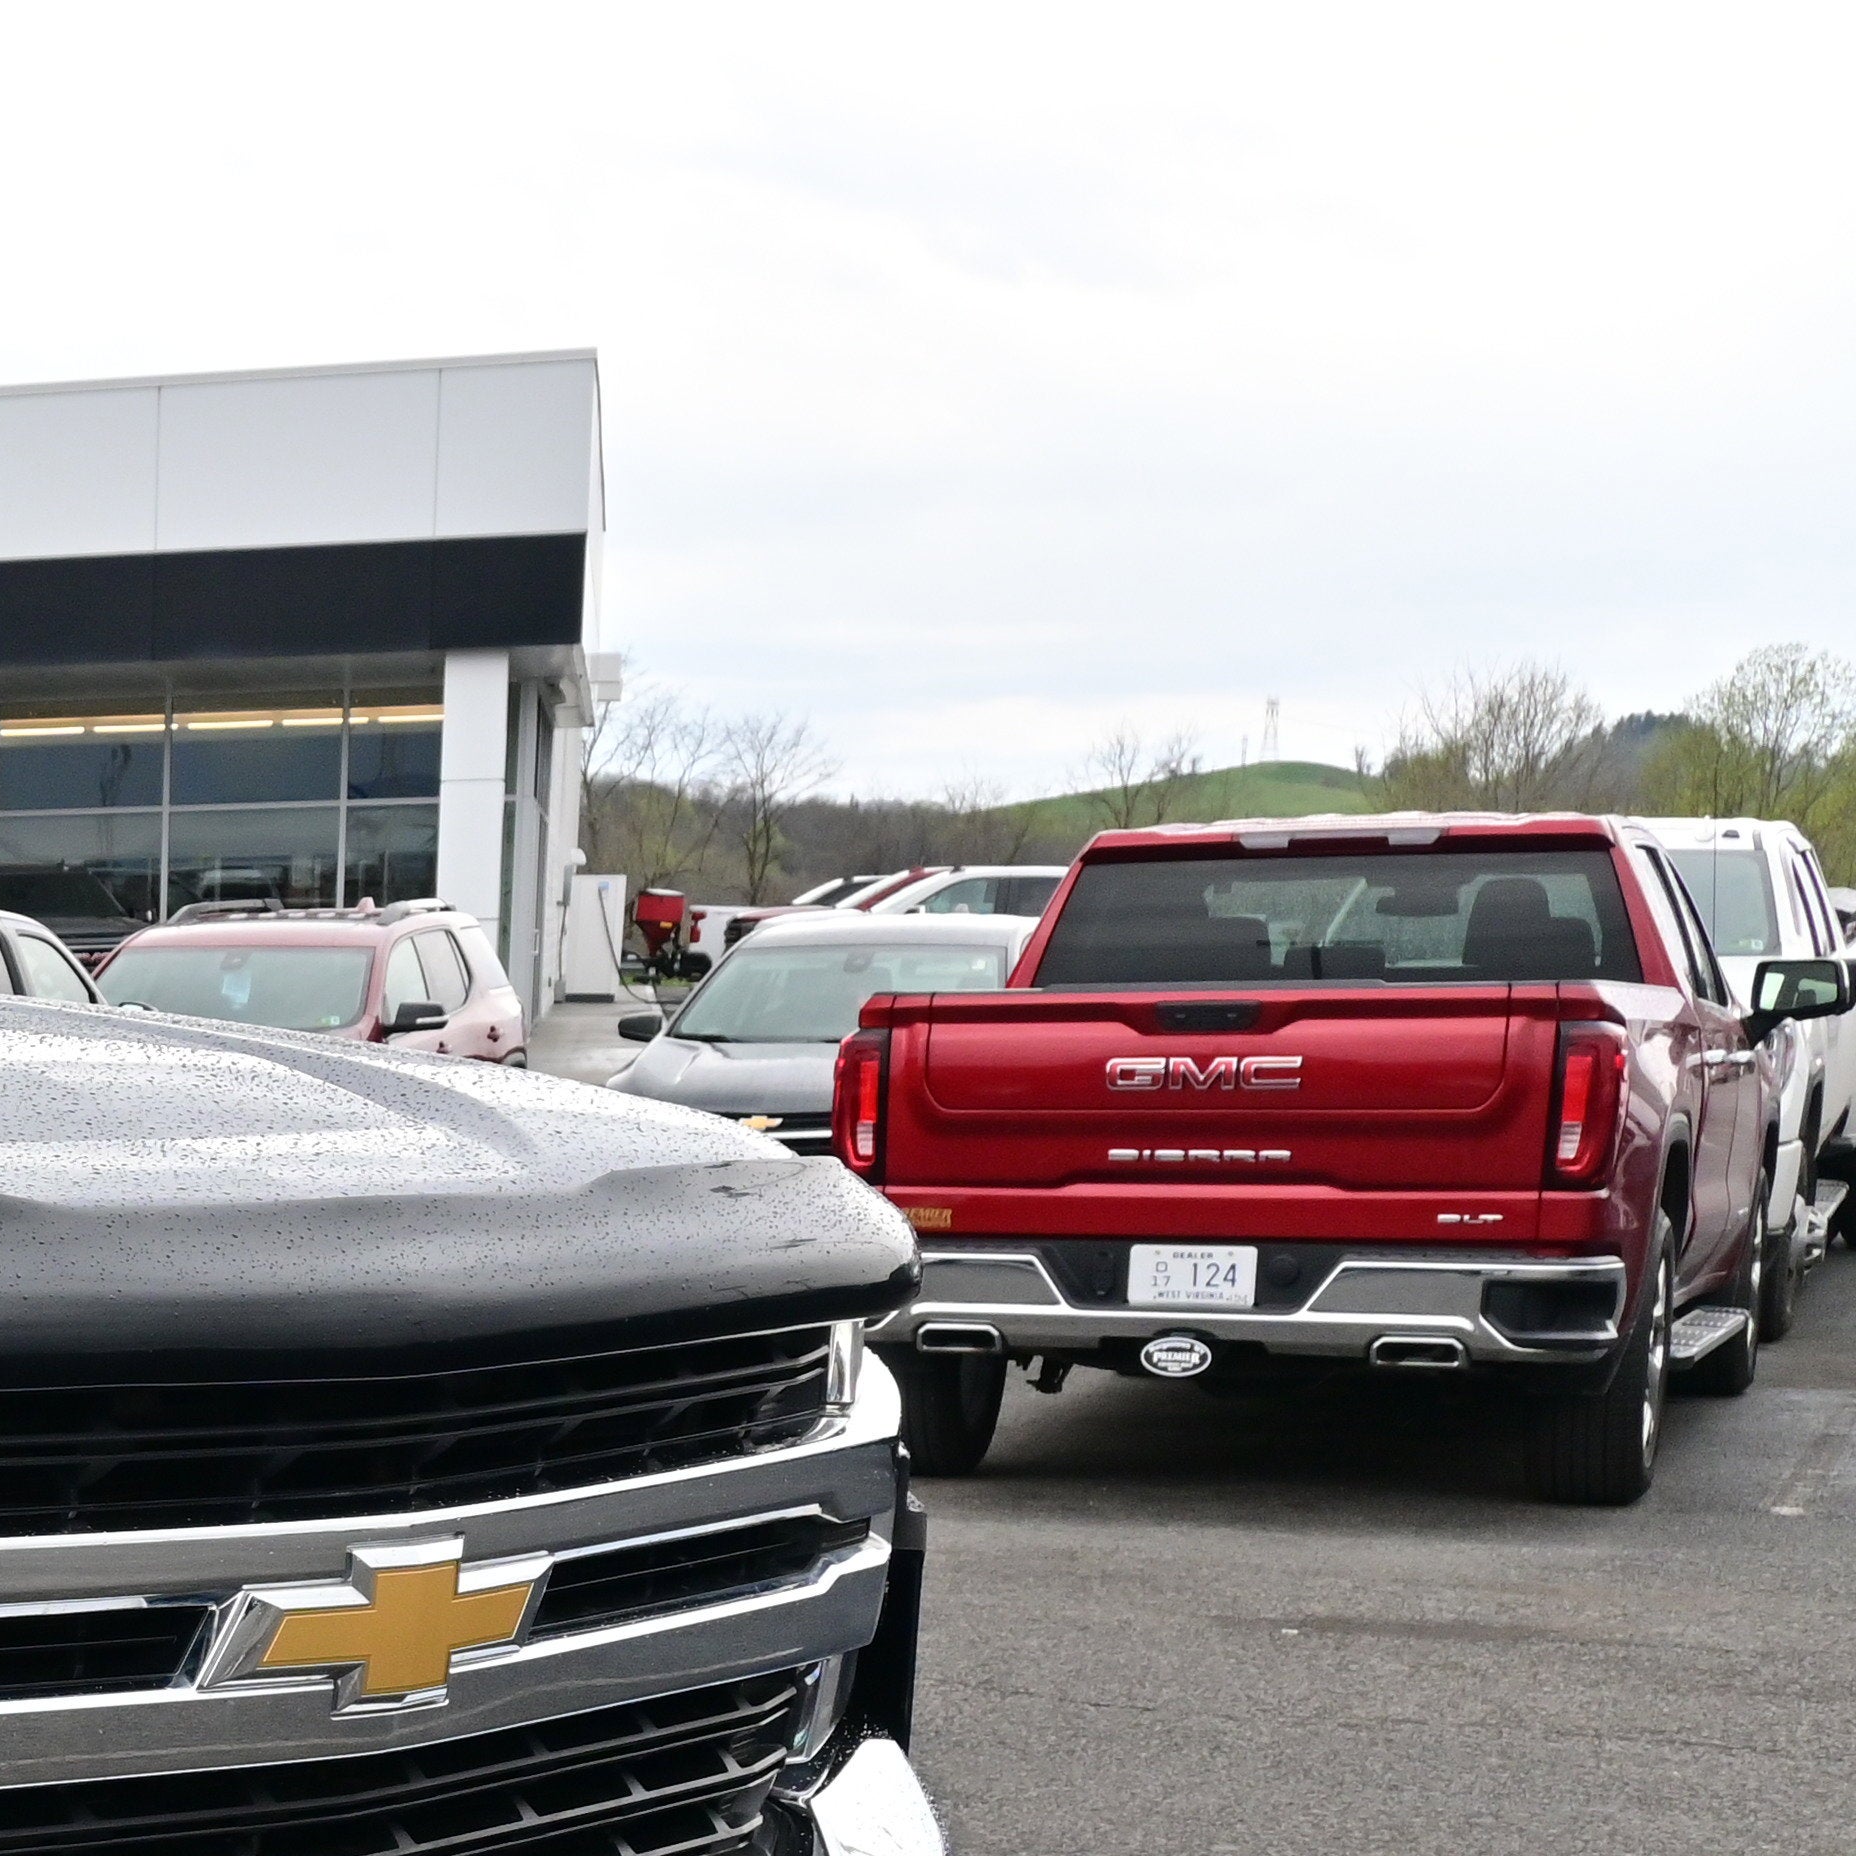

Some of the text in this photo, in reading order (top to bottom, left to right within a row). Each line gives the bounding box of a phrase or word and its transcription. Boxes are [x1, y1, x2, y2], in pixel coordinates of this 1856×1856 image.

[1105, 1055, 1304, 1091] GMC
[1172, 1251, 1214, 1259] DEALER
[1151, 1275, 1171, 1287] 17
[1192, 1262, 1238, 1288] 124
[1157, 1290, 1181, 1299] WEST
[1185, 1290, 1225, 1300] VIRGINIA
